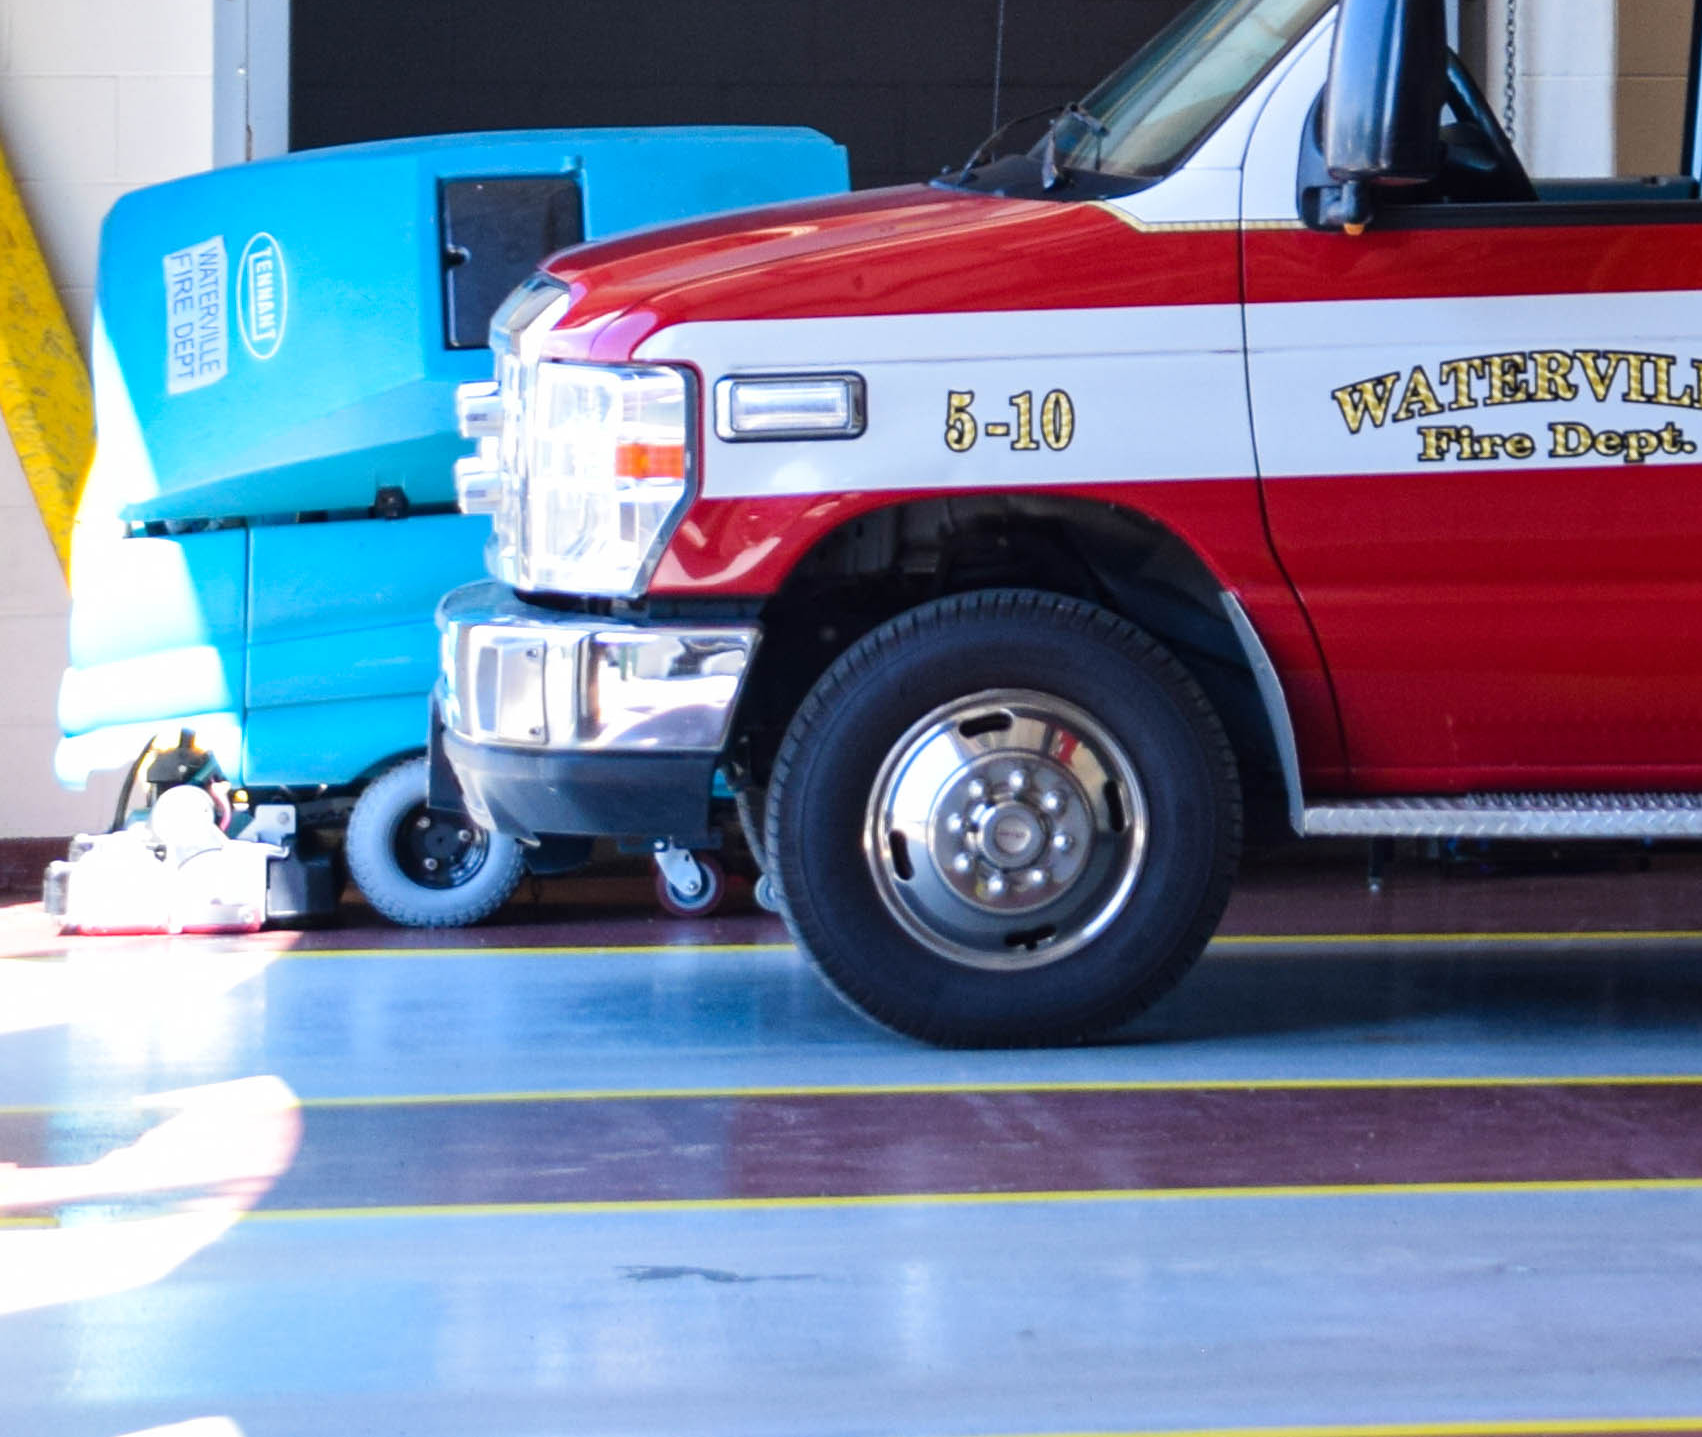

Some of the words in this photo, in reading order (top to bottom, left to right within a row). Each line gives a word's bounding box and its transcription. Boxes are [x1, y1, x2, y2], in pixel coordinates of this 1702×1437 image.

[170, 253, 194, 315] FIRE
[199, 245, 221, 376] WATERVILLE
[248, 246, 276, 341] TENNANT
[173, 322, 194, 378] DEPT
[944, 388, 1076, 453] 5-10
[1417, 425, 1536, 462] Fire
[1548, 421, 1698, 464] Dept.
